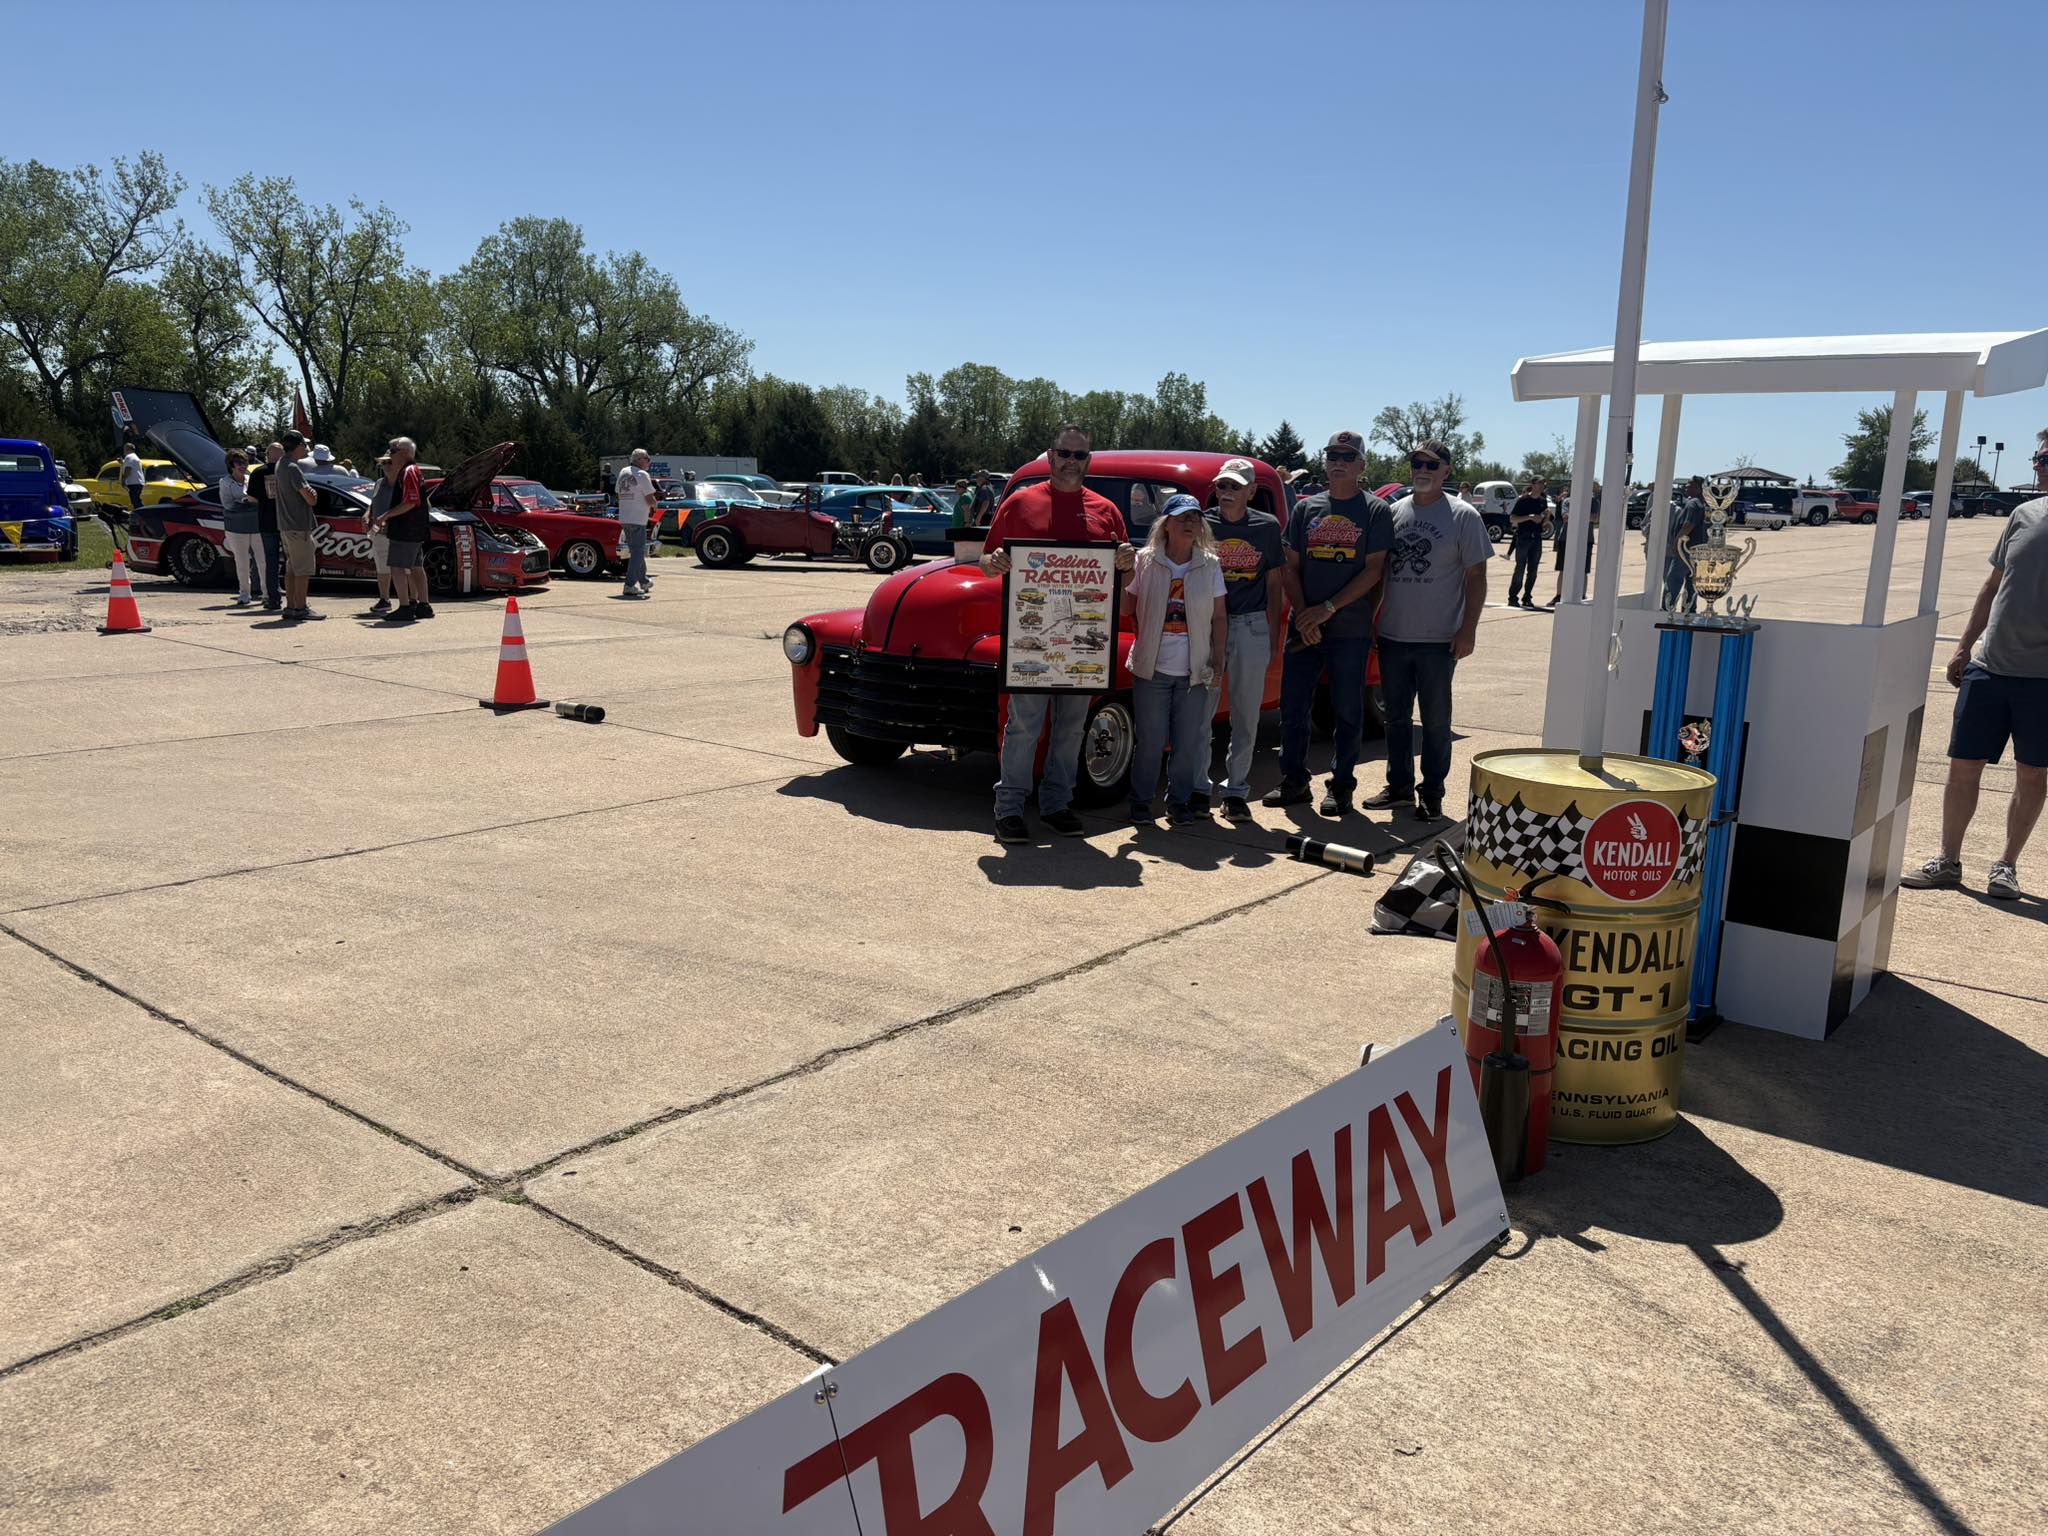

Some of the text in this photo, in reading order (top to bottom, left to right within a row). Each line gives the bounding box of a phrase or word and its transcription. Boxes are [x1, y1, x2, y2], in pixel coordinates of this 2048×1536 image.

[1045, 554, 1101, 568] Salina
[1219, 553, 1262, 568] ACEWAY
[1018, 569, 1107, 584] RACEWAY
[1593, 841, 1672, 867] KENDALL
[1603, 870, 1662, 881] MOTOR OILS
[1562, 983, 1671, 1012] GT-1
[1556, 1032, 1679, 1061] ACING OIL
[1552, 1087, 1669, 1105] NNSYLVANIA
[1560, 1107, 1584, 1118] U.S.
[1588, 1111, 1622, 1120] FLUID
[1625, 1106, 1657, 1119] QUART
[782, 1065, 1456, 1536] RACEWAY
